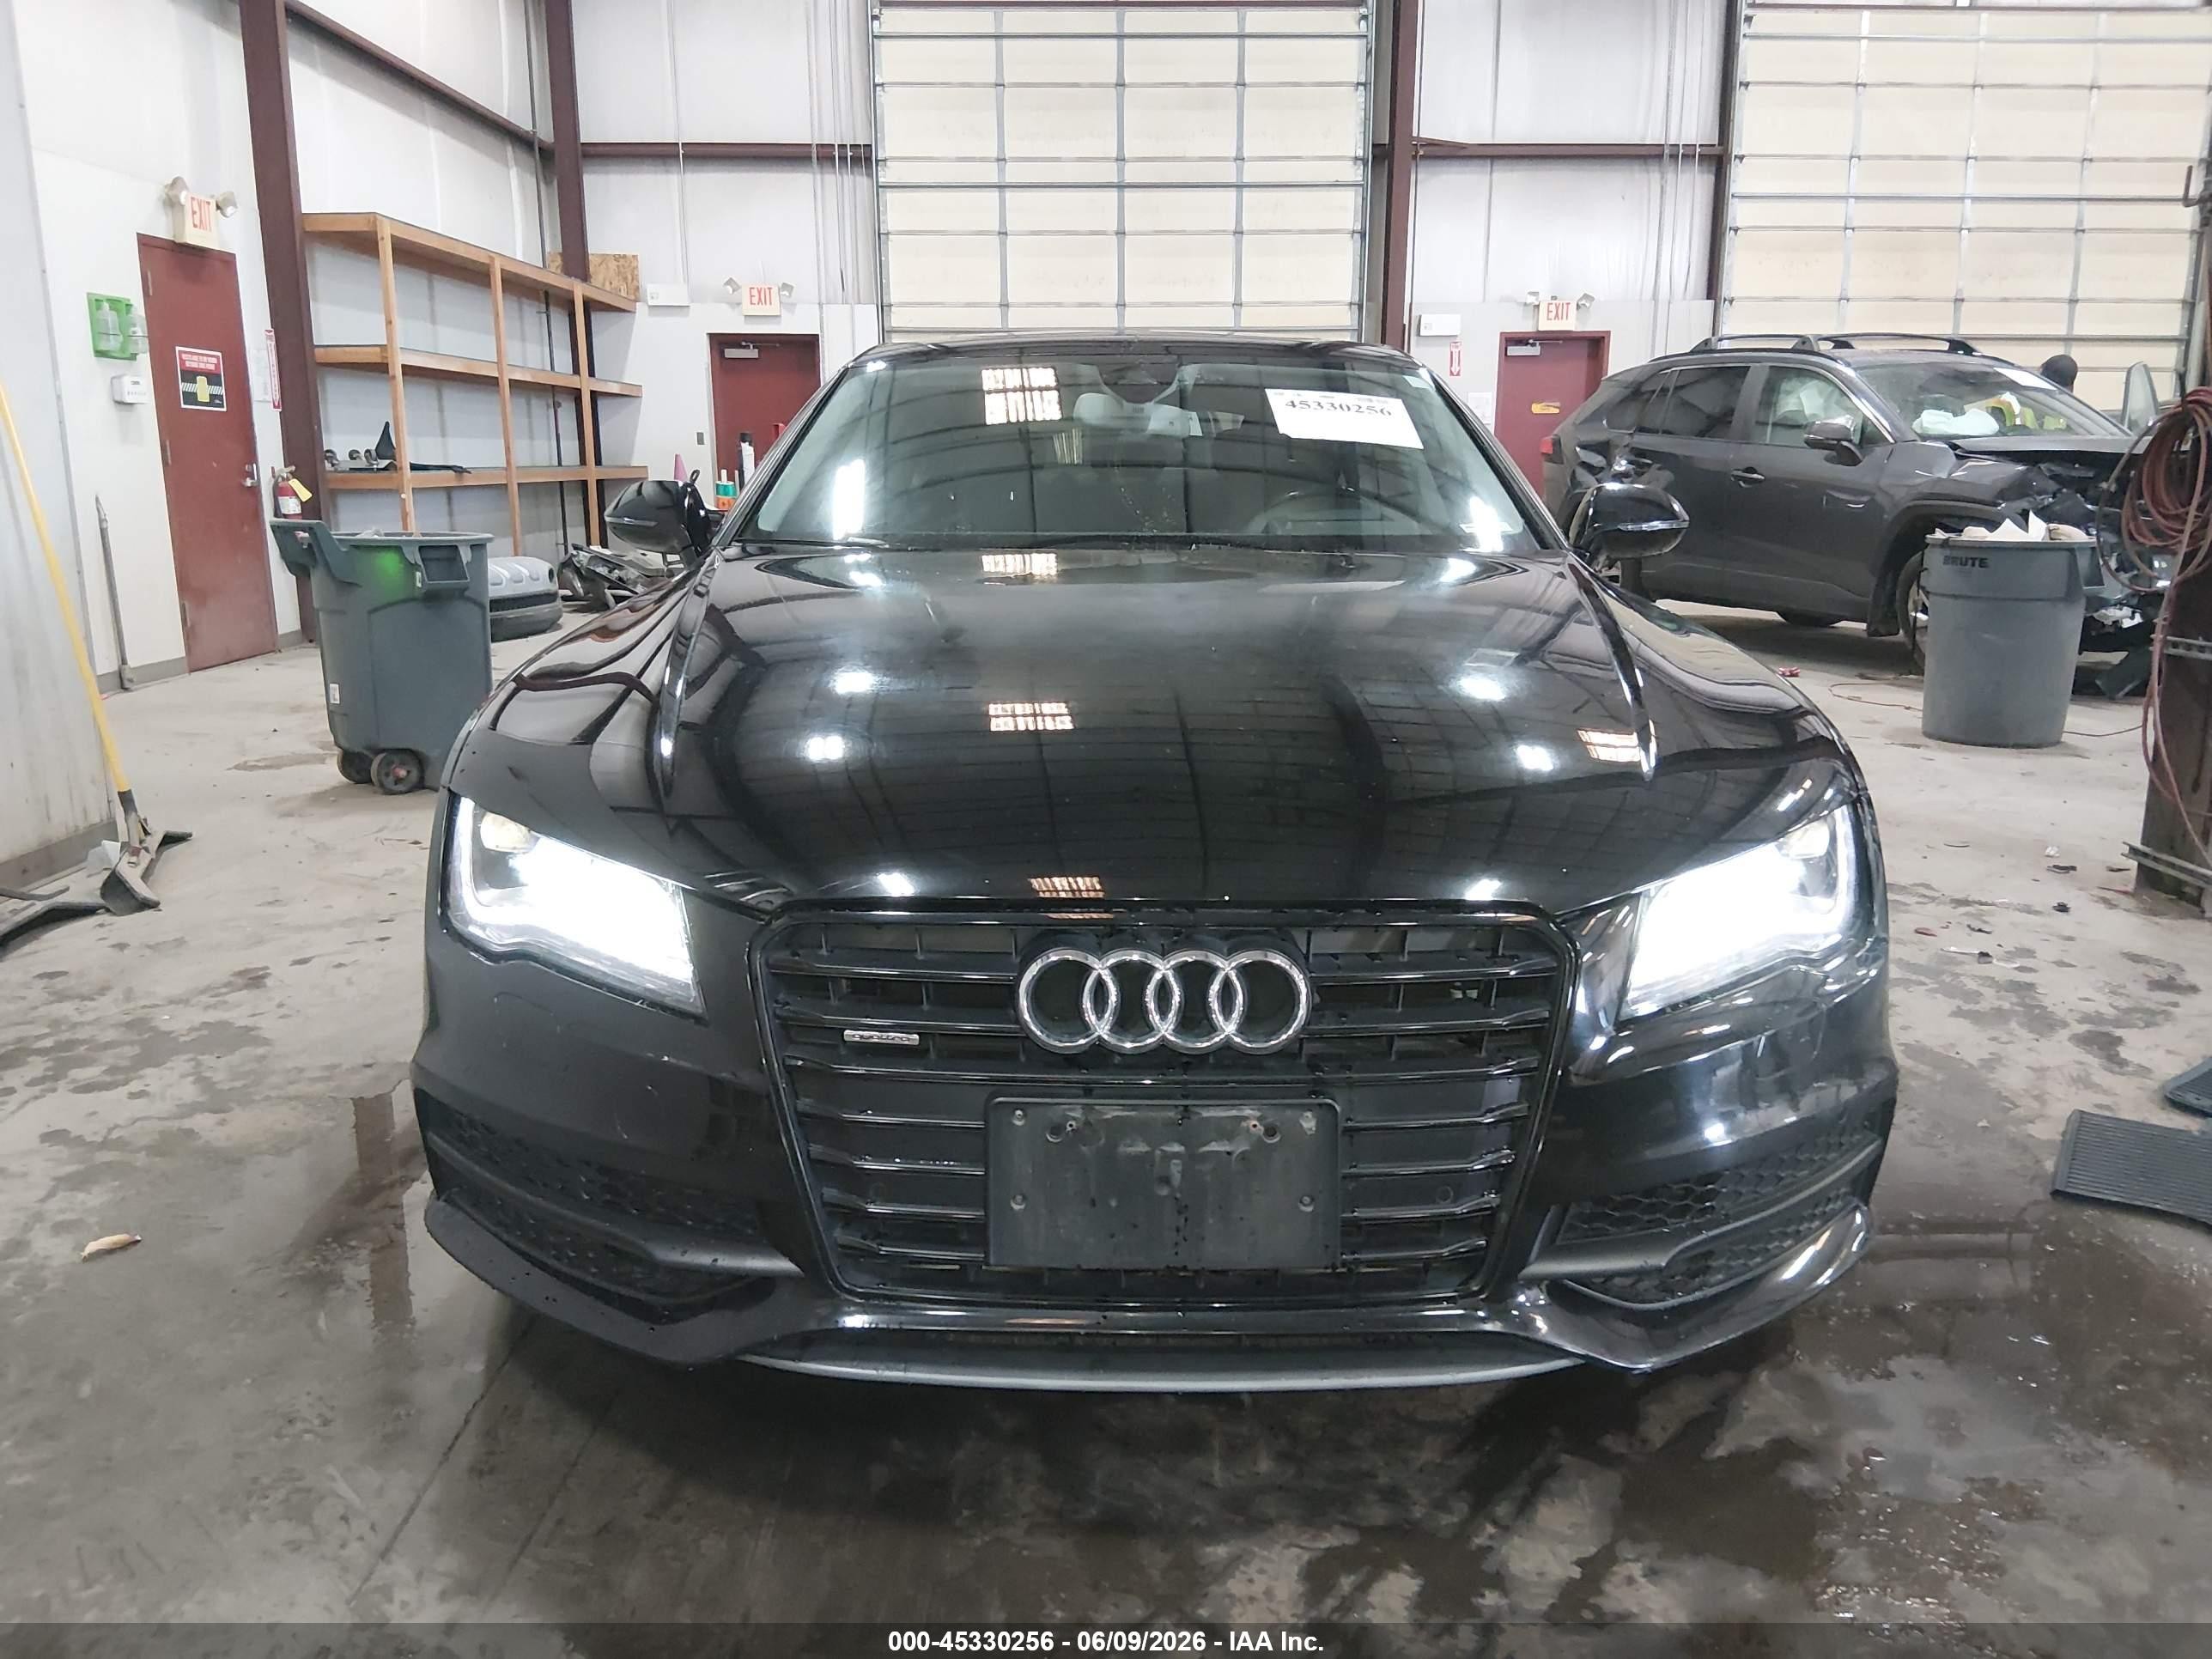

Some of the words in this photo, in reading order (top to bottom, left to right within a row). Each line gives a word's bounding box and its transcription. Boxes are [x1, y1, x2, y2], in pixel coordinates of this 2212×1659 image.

[191, 197, 212, 232] EXIT
[749, 287, 773, 305] EXIT
[1547, 302, 1571, 320] EXIT
[1285, 400, 1392, 416] 45330256
[1943, 555, 1989, 568] BRUTE
